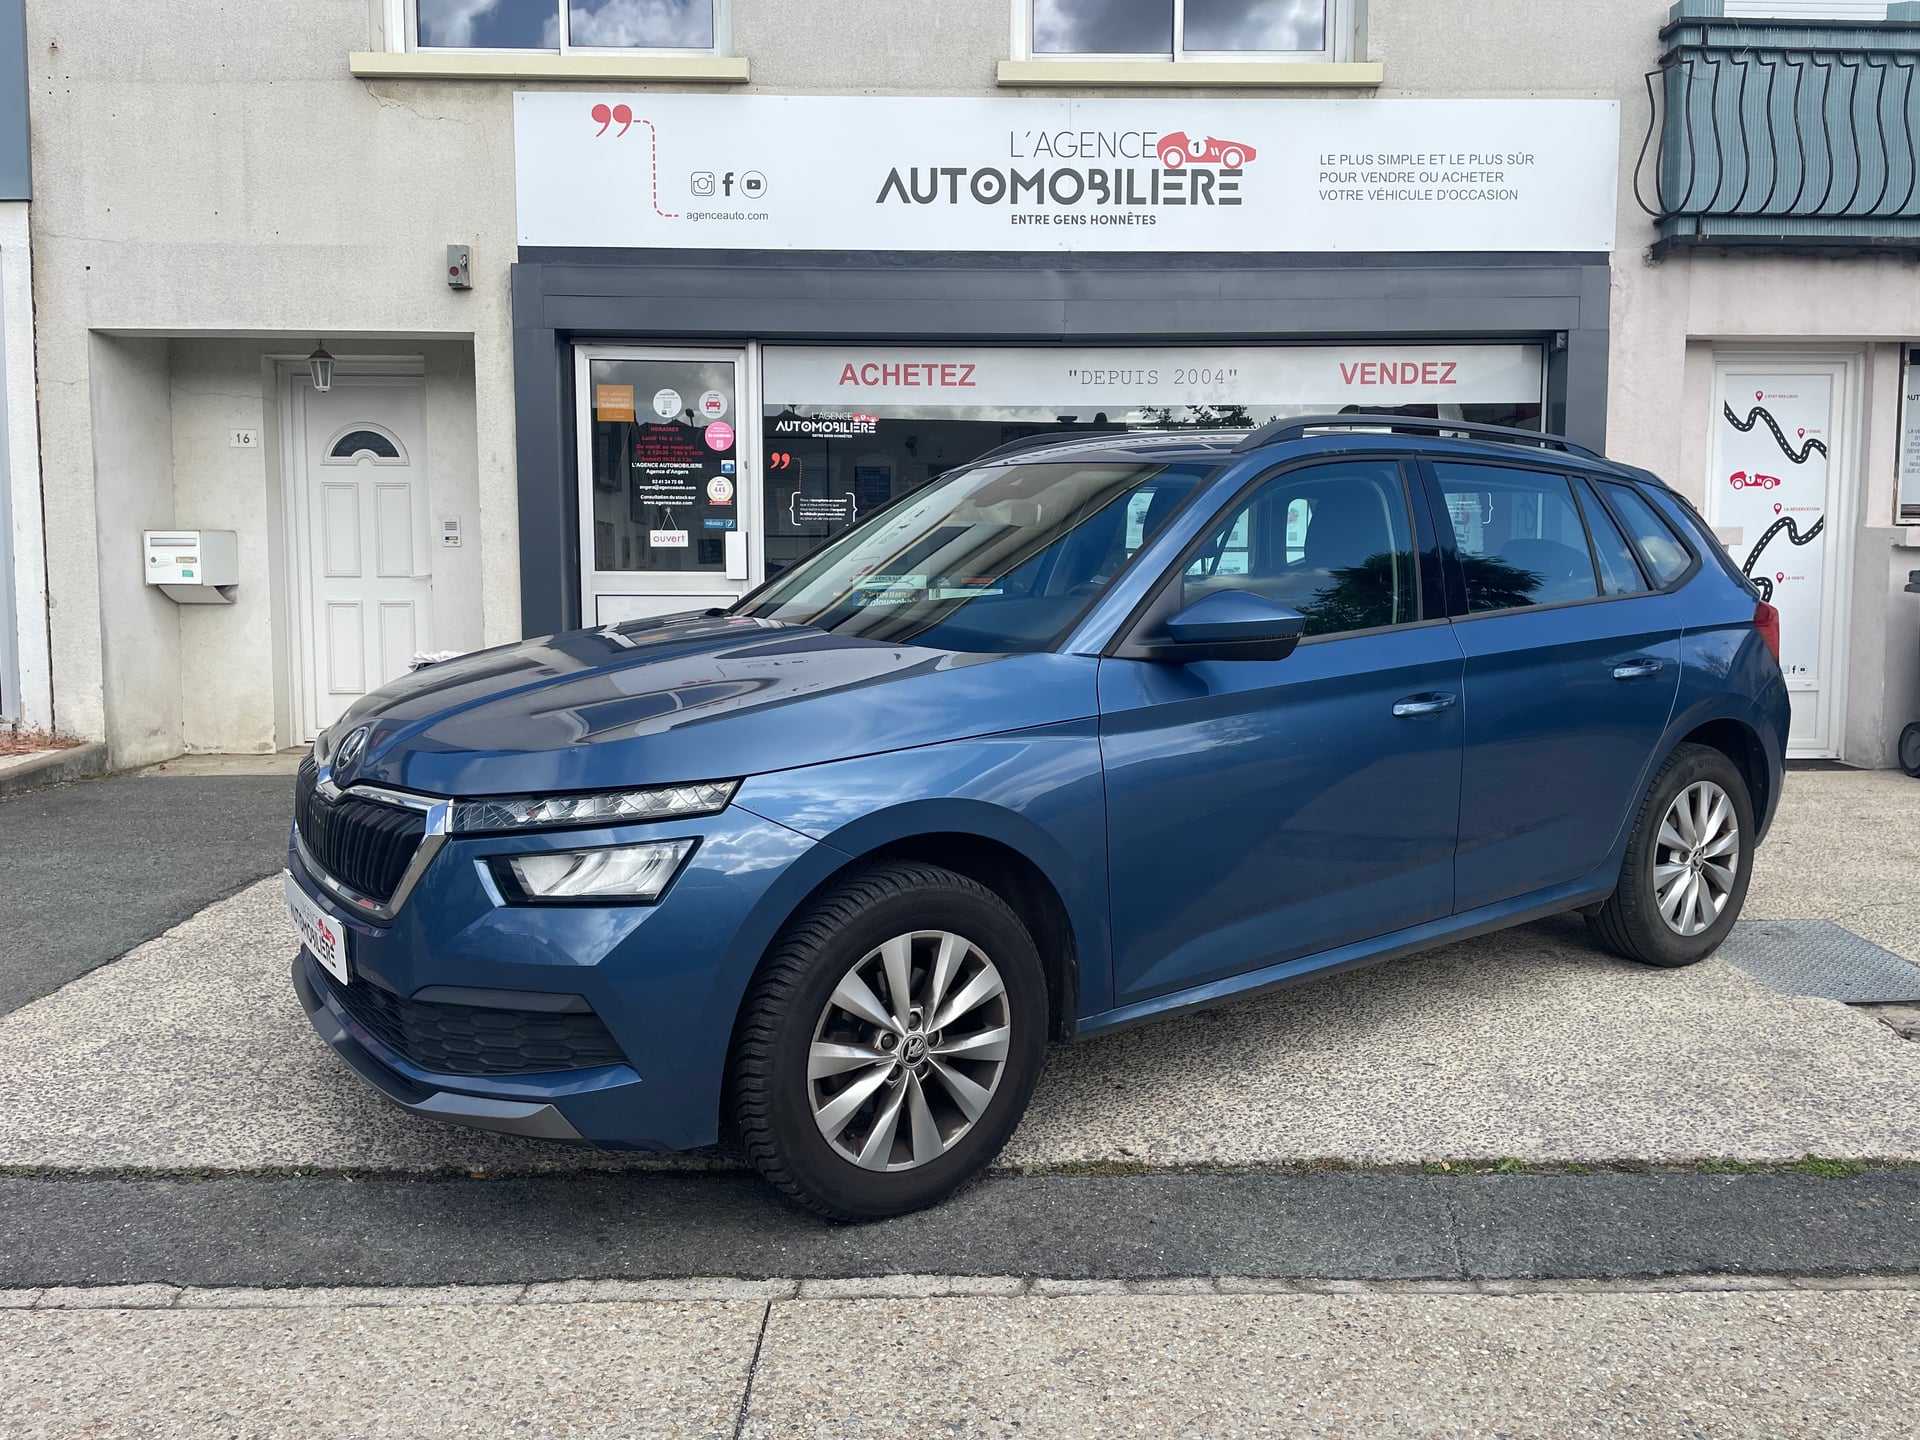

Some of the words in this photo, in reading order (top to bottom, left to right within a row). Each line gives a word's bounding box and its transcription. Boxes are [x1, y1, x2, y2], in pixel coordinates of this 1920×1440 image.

[1010, 131, 1158, 158] L'AGENCE
[1320, 154, 1336, 165] LE
[1339, 154, 1374, 165] PLUS
[1377, 154, 1426, 165] SIMPLE
[1429, 154, 1446, 165] ET
[1449, 154, 1465, 165] LE
[1468, 154, 1503, 165] PLUS
[1506, 152, 1535, 165] SÛR
[1319, 171, 1358, 183] POUR
[1361, 171, 1415, 183] VENDRE
[1418, 171, 1439, 183] OU
[1442, 171, 1504, 183] ACHETER
[1319, 189, 1364, 201] VOTRE
[1367, 187, 1433, 201] VÉHICULE
[1437, 189, 1519, 201] D'OCCASION
[686, 211, 769, 222] agenceauto.com
[1011, 214, 1050, 225] ENTRE
[1053, 214, 1087, 225] GENS
[1090, 211, 1157, 226] HONNÊTES
[838, 363, 976, 387] ACHETEZ
[1339, 362, 1457, 385] VENDEZ
[236, 433, 250, 444] 16
[653, 535, 685, 543] ouvert
